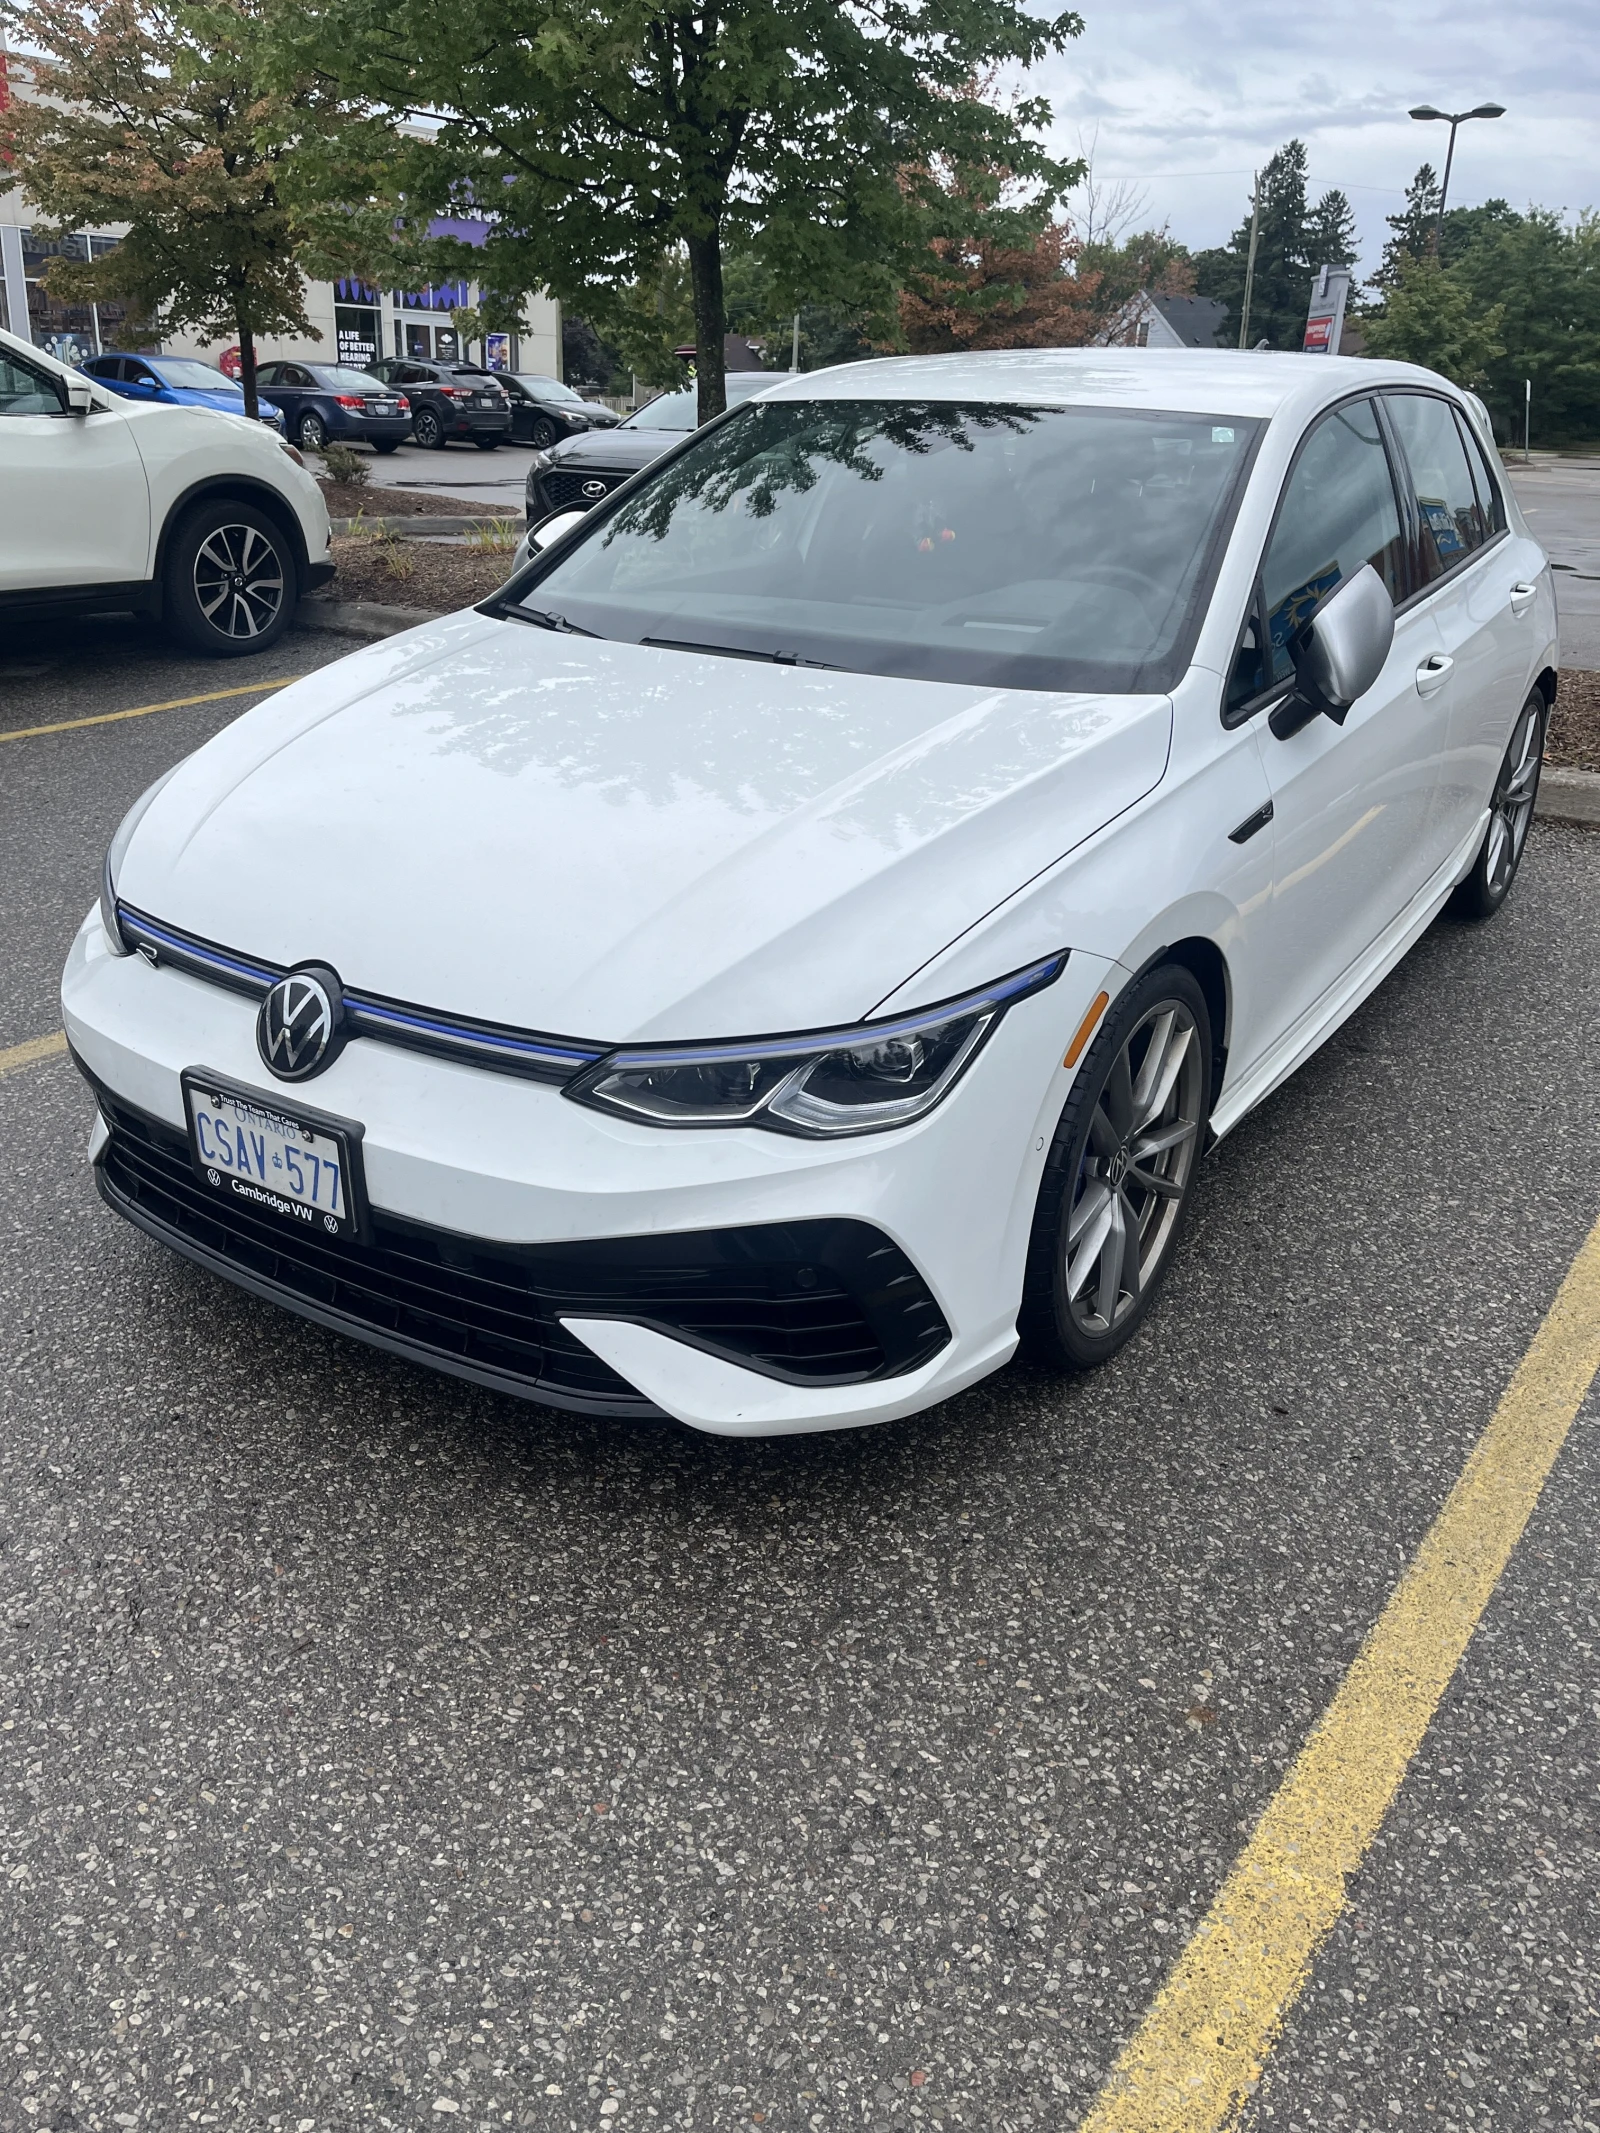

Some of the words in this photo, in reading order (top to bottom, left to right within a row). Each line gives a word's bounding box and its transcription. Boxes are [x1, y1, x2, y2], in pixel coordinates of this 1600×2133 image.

[338, 330, 344, 340] A
[344, 330, 360, 341] LIFE
[339, 341, 349, 351] OF
[349, 342, 375, 353] BETTER
[340, 352, 371, 363] HEARING
[341, 362, 367, 370] RTS
[219, 1094, 236, 1106] Trust
[235, 1100, 248, 1111] The
[247, 1105, 265, 1117] Team
[265, 1110, 281, 1122] That
[281, 1116, 300, 1129] Cares
[197, 1112, 265, 1180] CSAV
[284, 1145, 339, 1210] 577
[231, 1179, 291, 1213] Cambridge
[290, 1202, 313, 1221] VW
